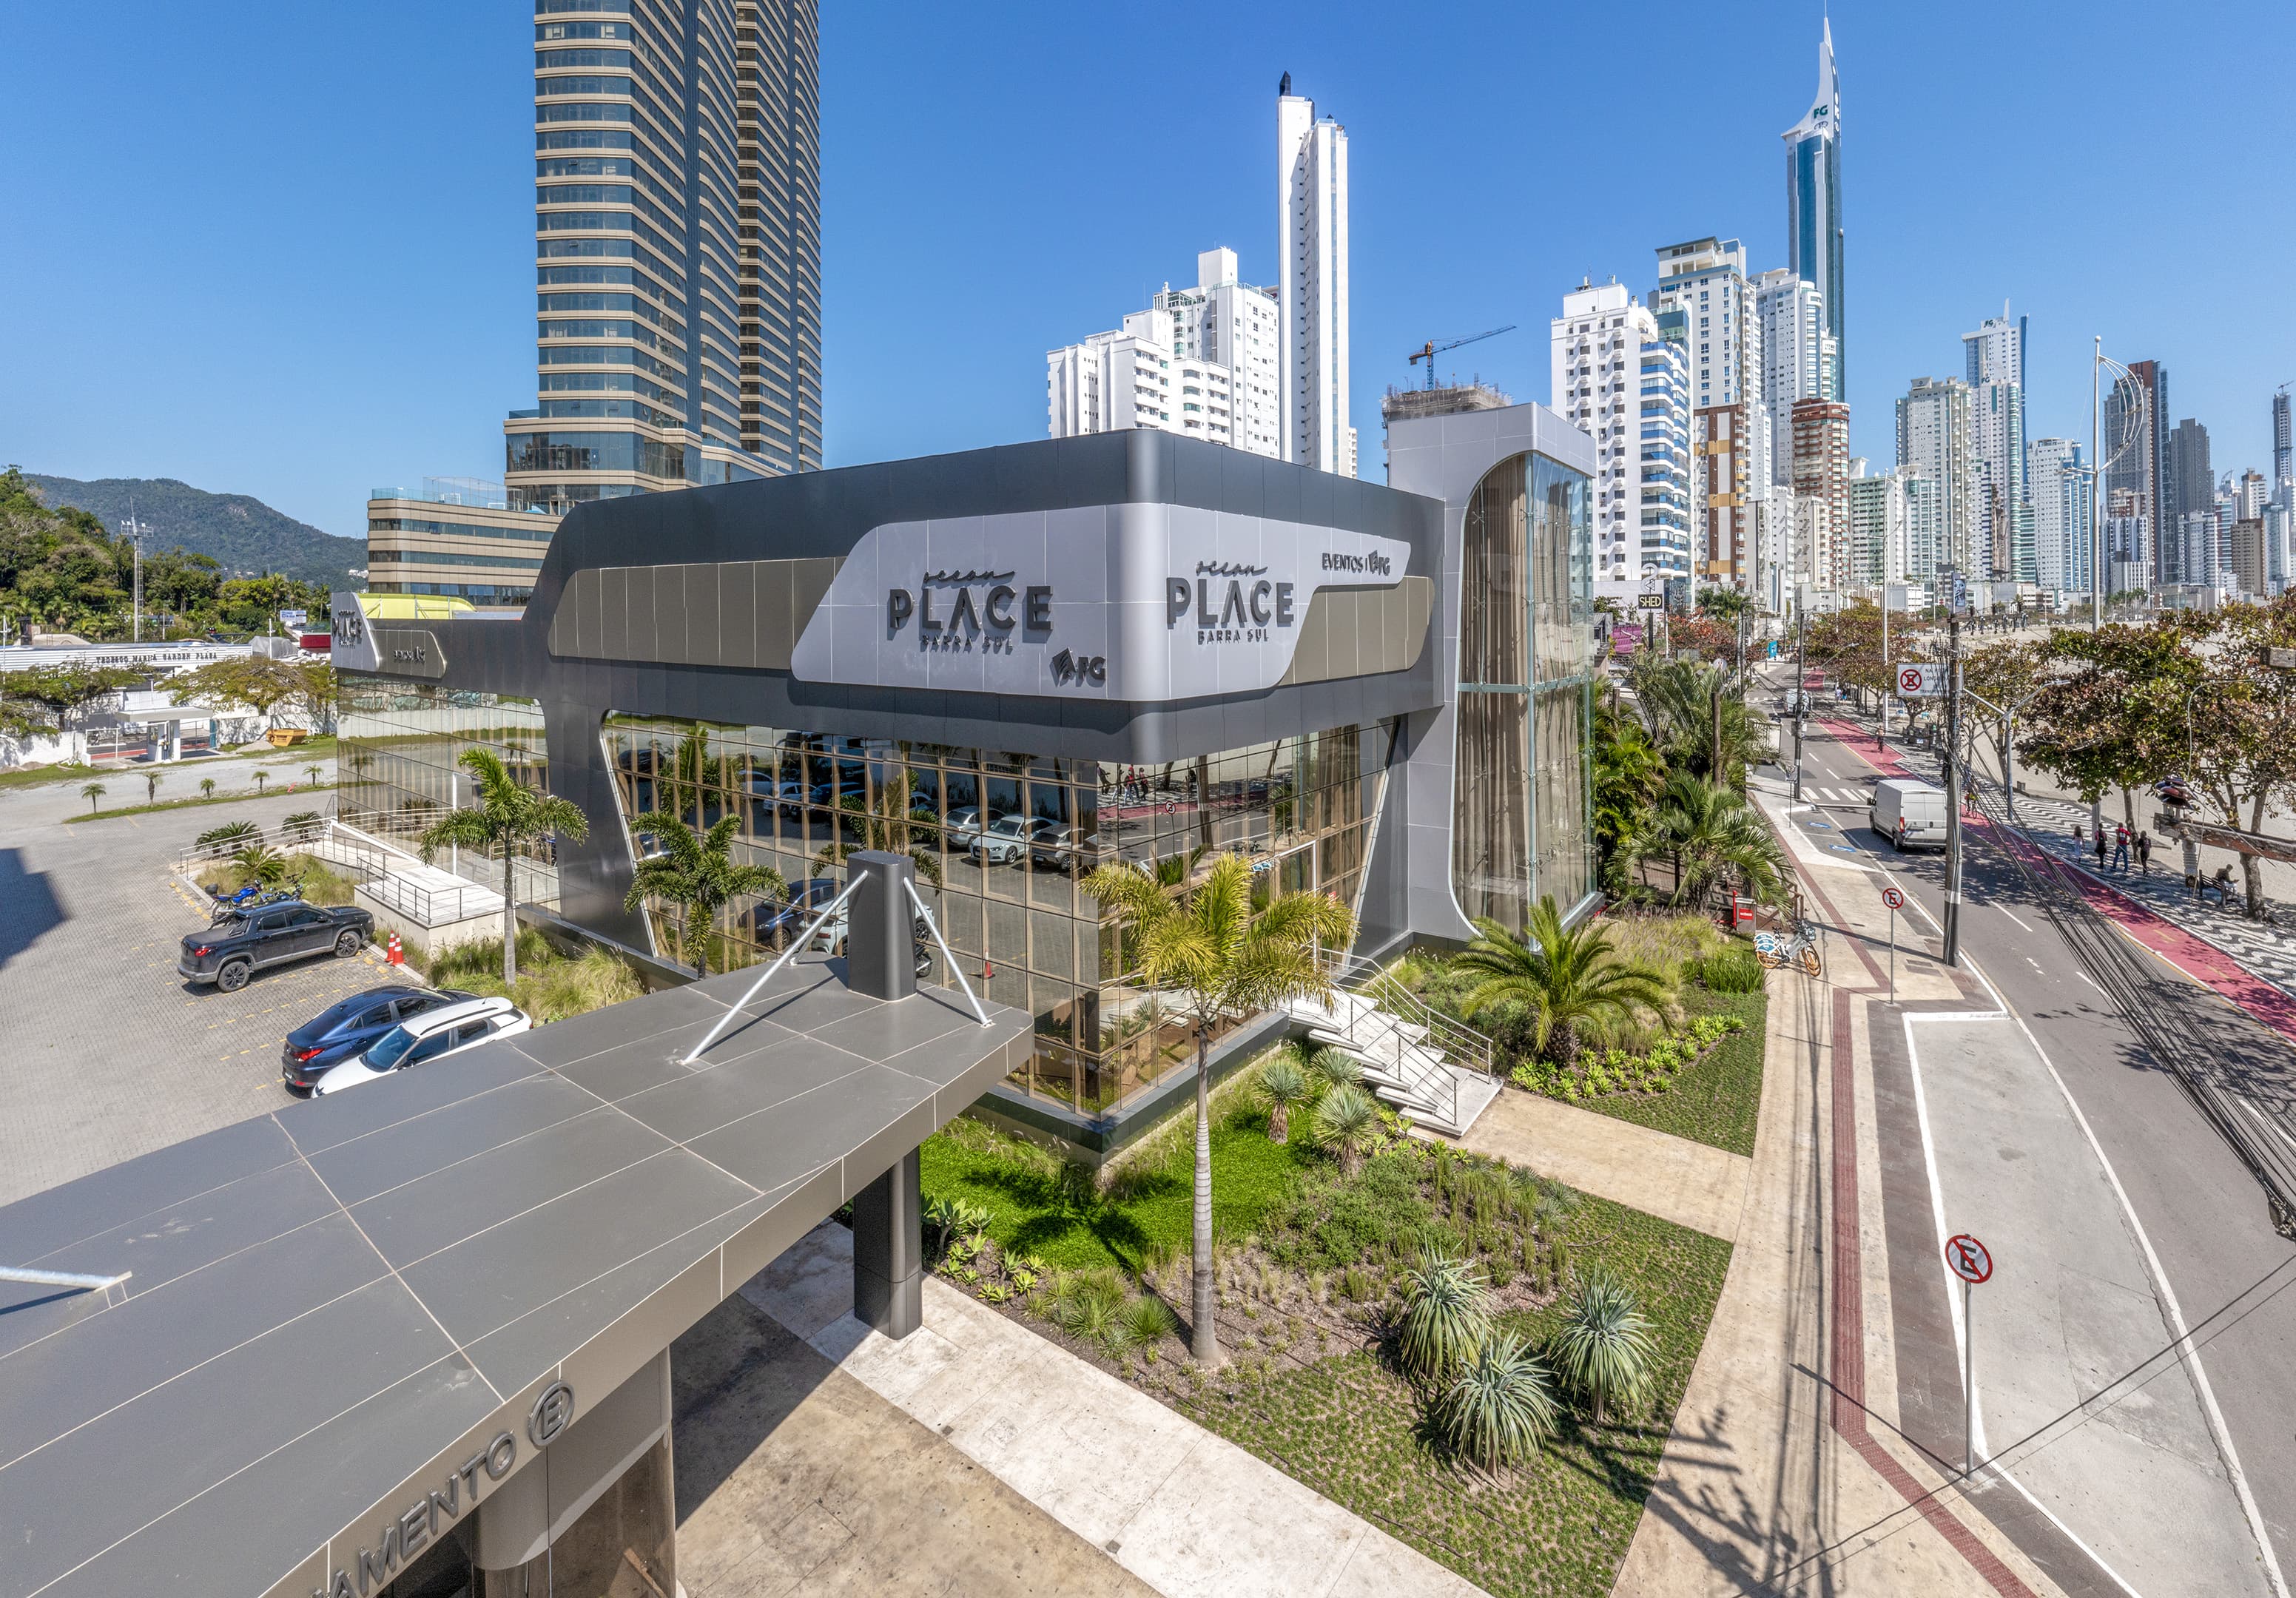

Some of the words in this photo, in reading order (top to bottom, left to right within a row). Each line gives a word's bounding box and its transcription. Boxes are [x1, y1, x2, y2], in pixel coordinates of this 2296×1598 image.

[1814, 104, 1828, 119] FG
[1195, 560, 1268, 577] ocean
[1322, 552, 1364, 573] EVENTOS
[923, 569, 1016, 584] ocean
[889, 584, 1054, 630] PLACE
[1166, 577, 1294, 625] PLACE
[1639, 596, 1662, 607] SHED
[922, 635, 973, 647] BARRA
[984, 635, 1013, 647] SUL
[1197, 630, 1242, 645] BARRA
[1247, 629, 1269, 642] SUL
